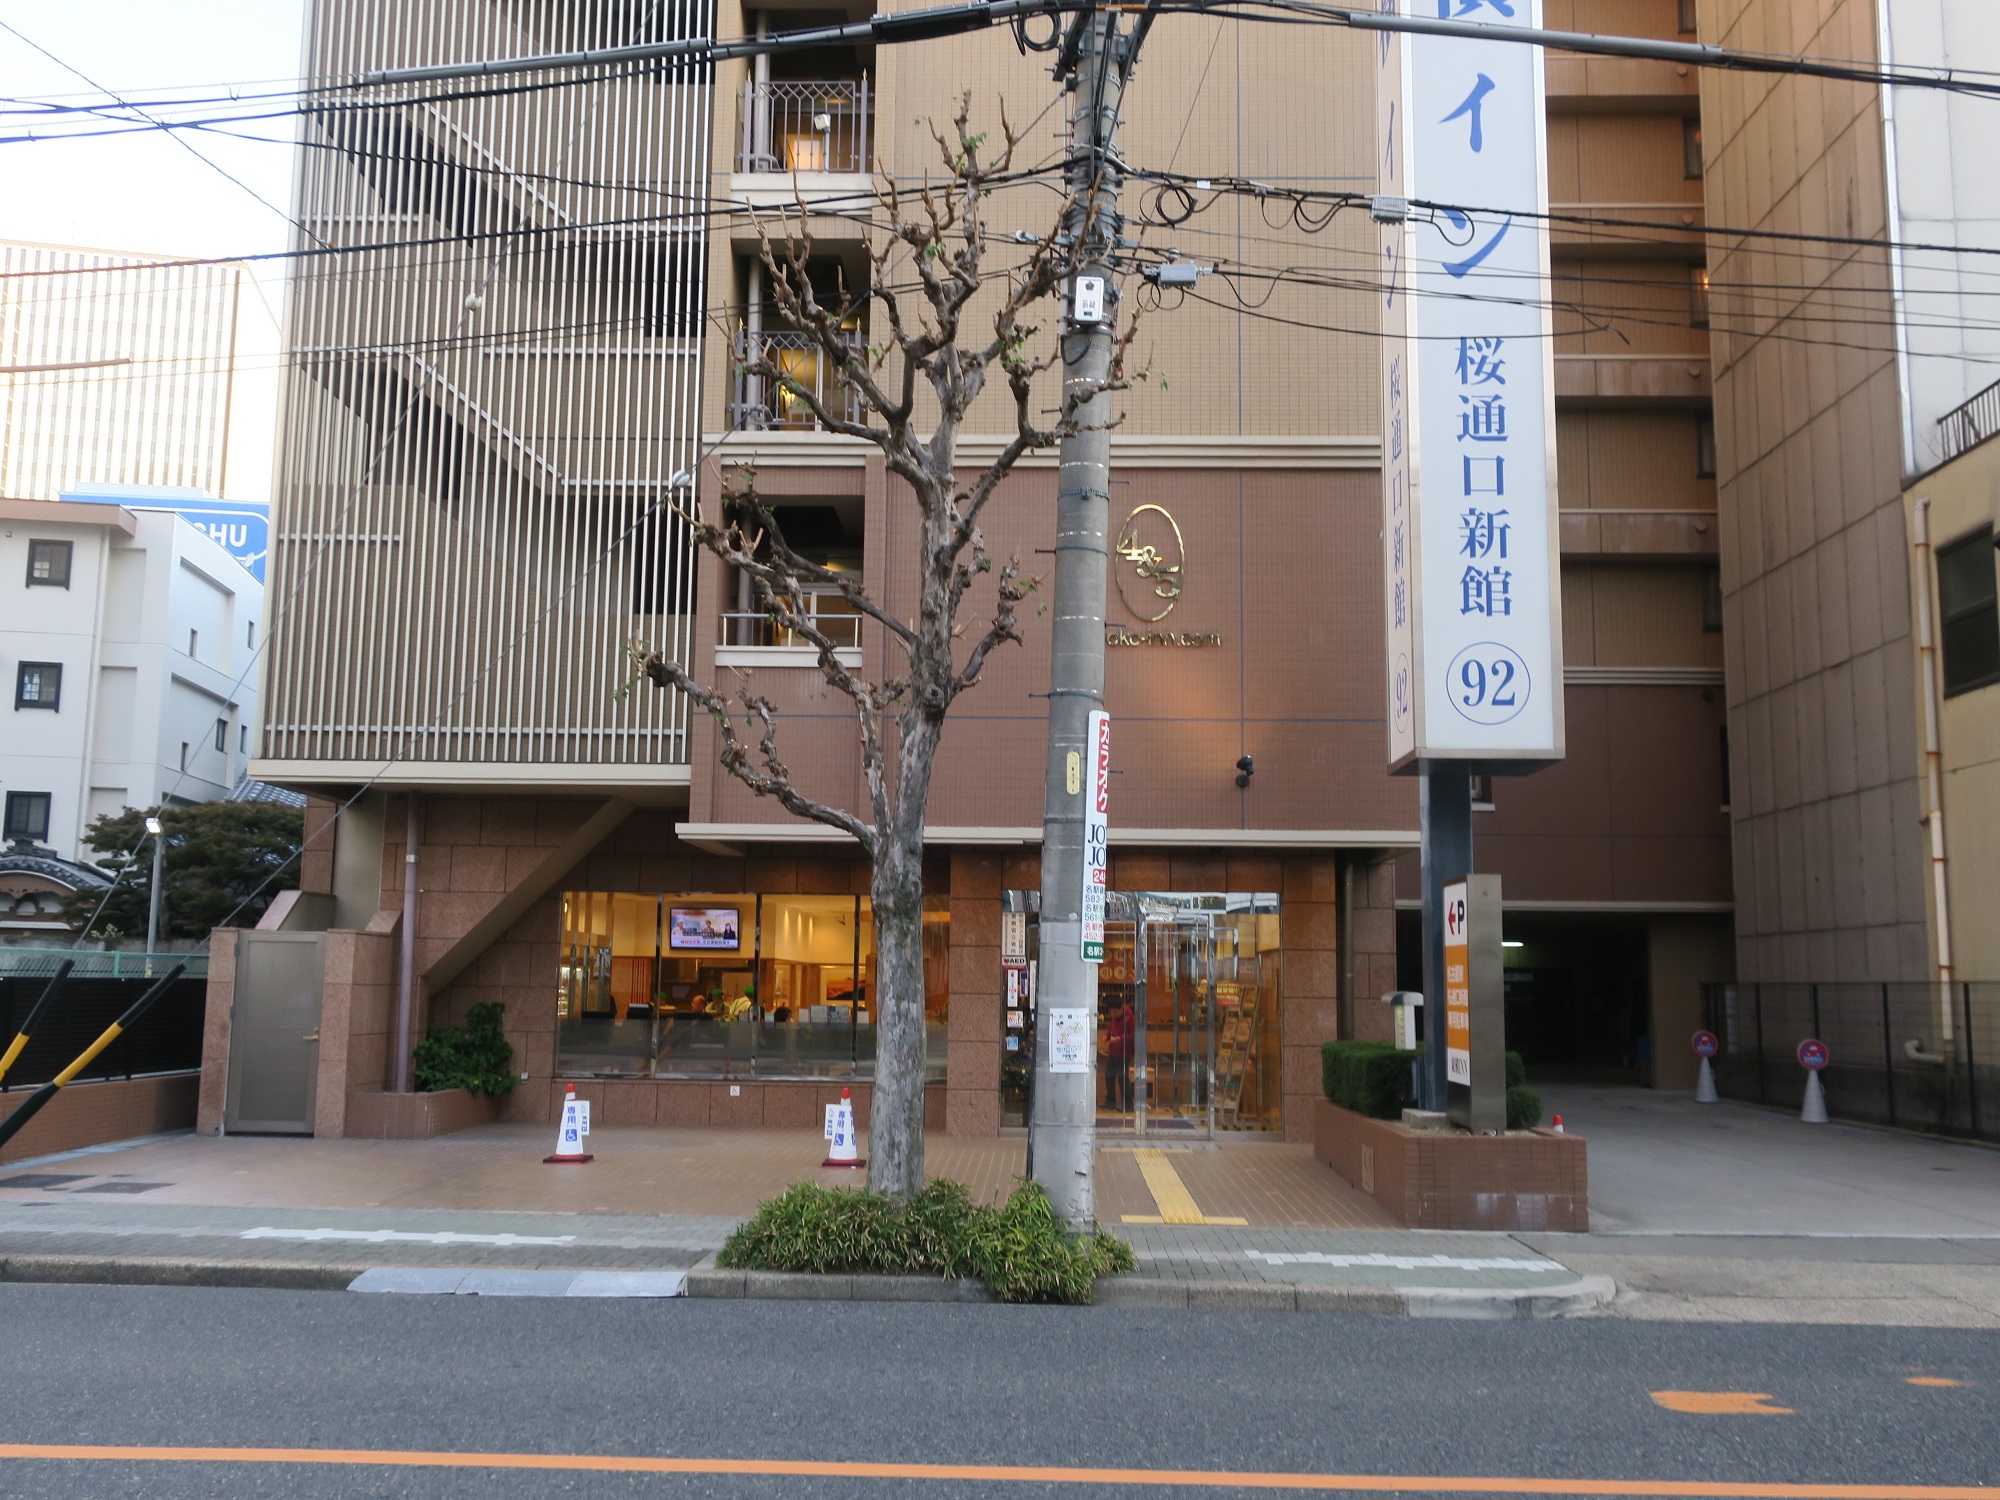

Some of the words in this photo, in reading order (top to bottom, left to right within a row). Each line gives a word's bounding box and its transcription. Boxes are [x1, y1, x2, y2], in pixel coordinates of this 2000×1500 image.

[1454, 336, 1513, 617] 桜通口新館
[1391, 353, 1405, 629] 桜通口新館
[1105, 628, 1221, 646] oko-inn.com
[1461, 658, 1517, 708] 92
[1088, 824, 1107, 845] JO
[1088, 846, 1107, 867] JO
[1457, 900, 1465, 934] P
[567, 1106, 576, 1124] 専用
